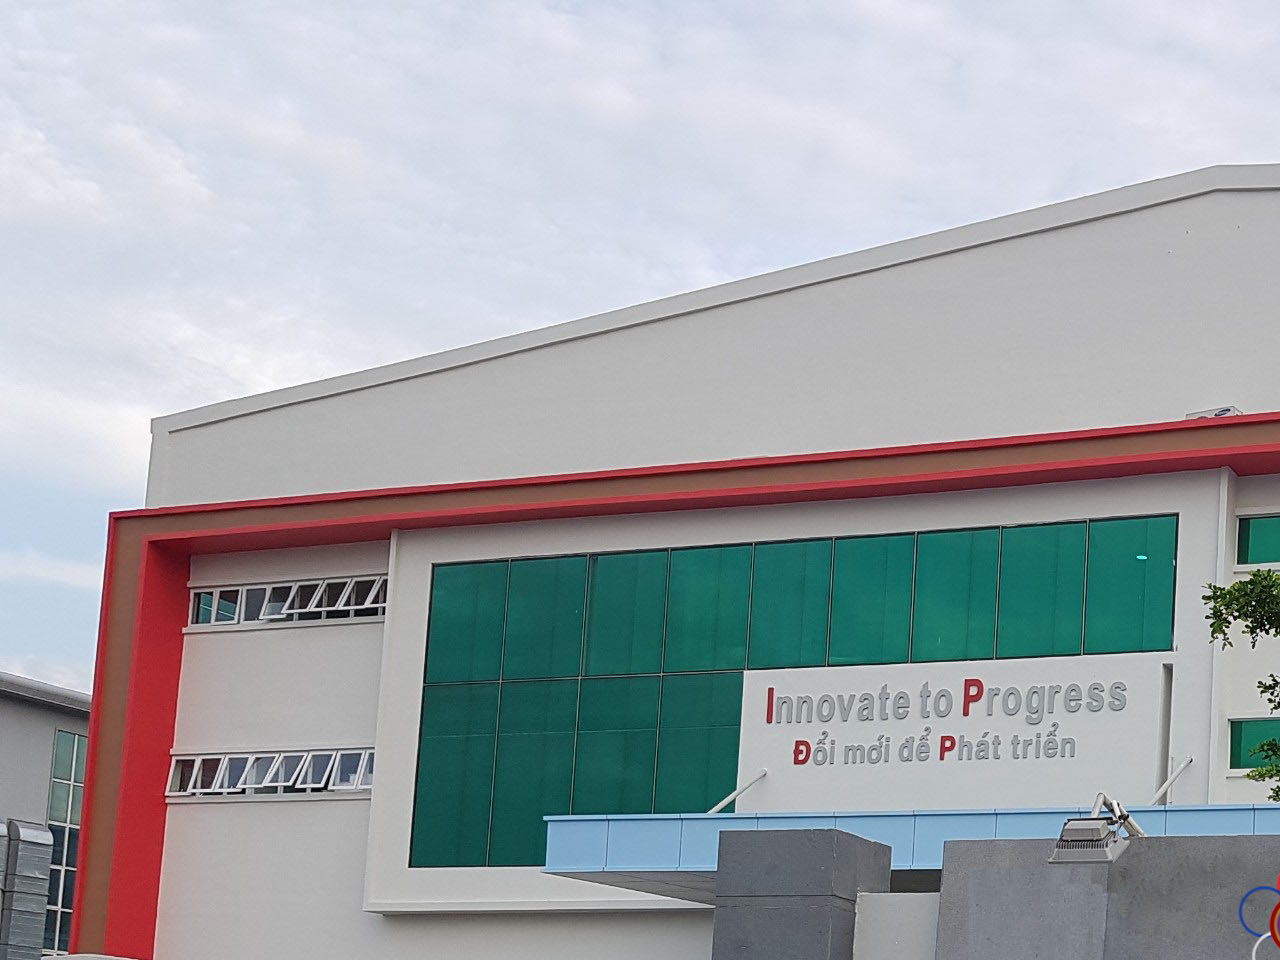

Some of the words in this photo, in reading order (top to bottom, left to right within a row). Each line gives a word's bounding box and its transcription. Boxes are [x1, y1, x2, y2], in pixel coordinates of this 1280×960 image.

[766, 682, 912, 725] Innovate
[920, 680, 954, 719] to
[962, 678, 1129, 726] Progress
[792, 729, 838, 767] Đổi
[843, 733, 892, 765] mới
[898, 726, 932, 763] để
[938, 730, 1003, 762] Phát
[1011, 721, 1078, 761] triển
